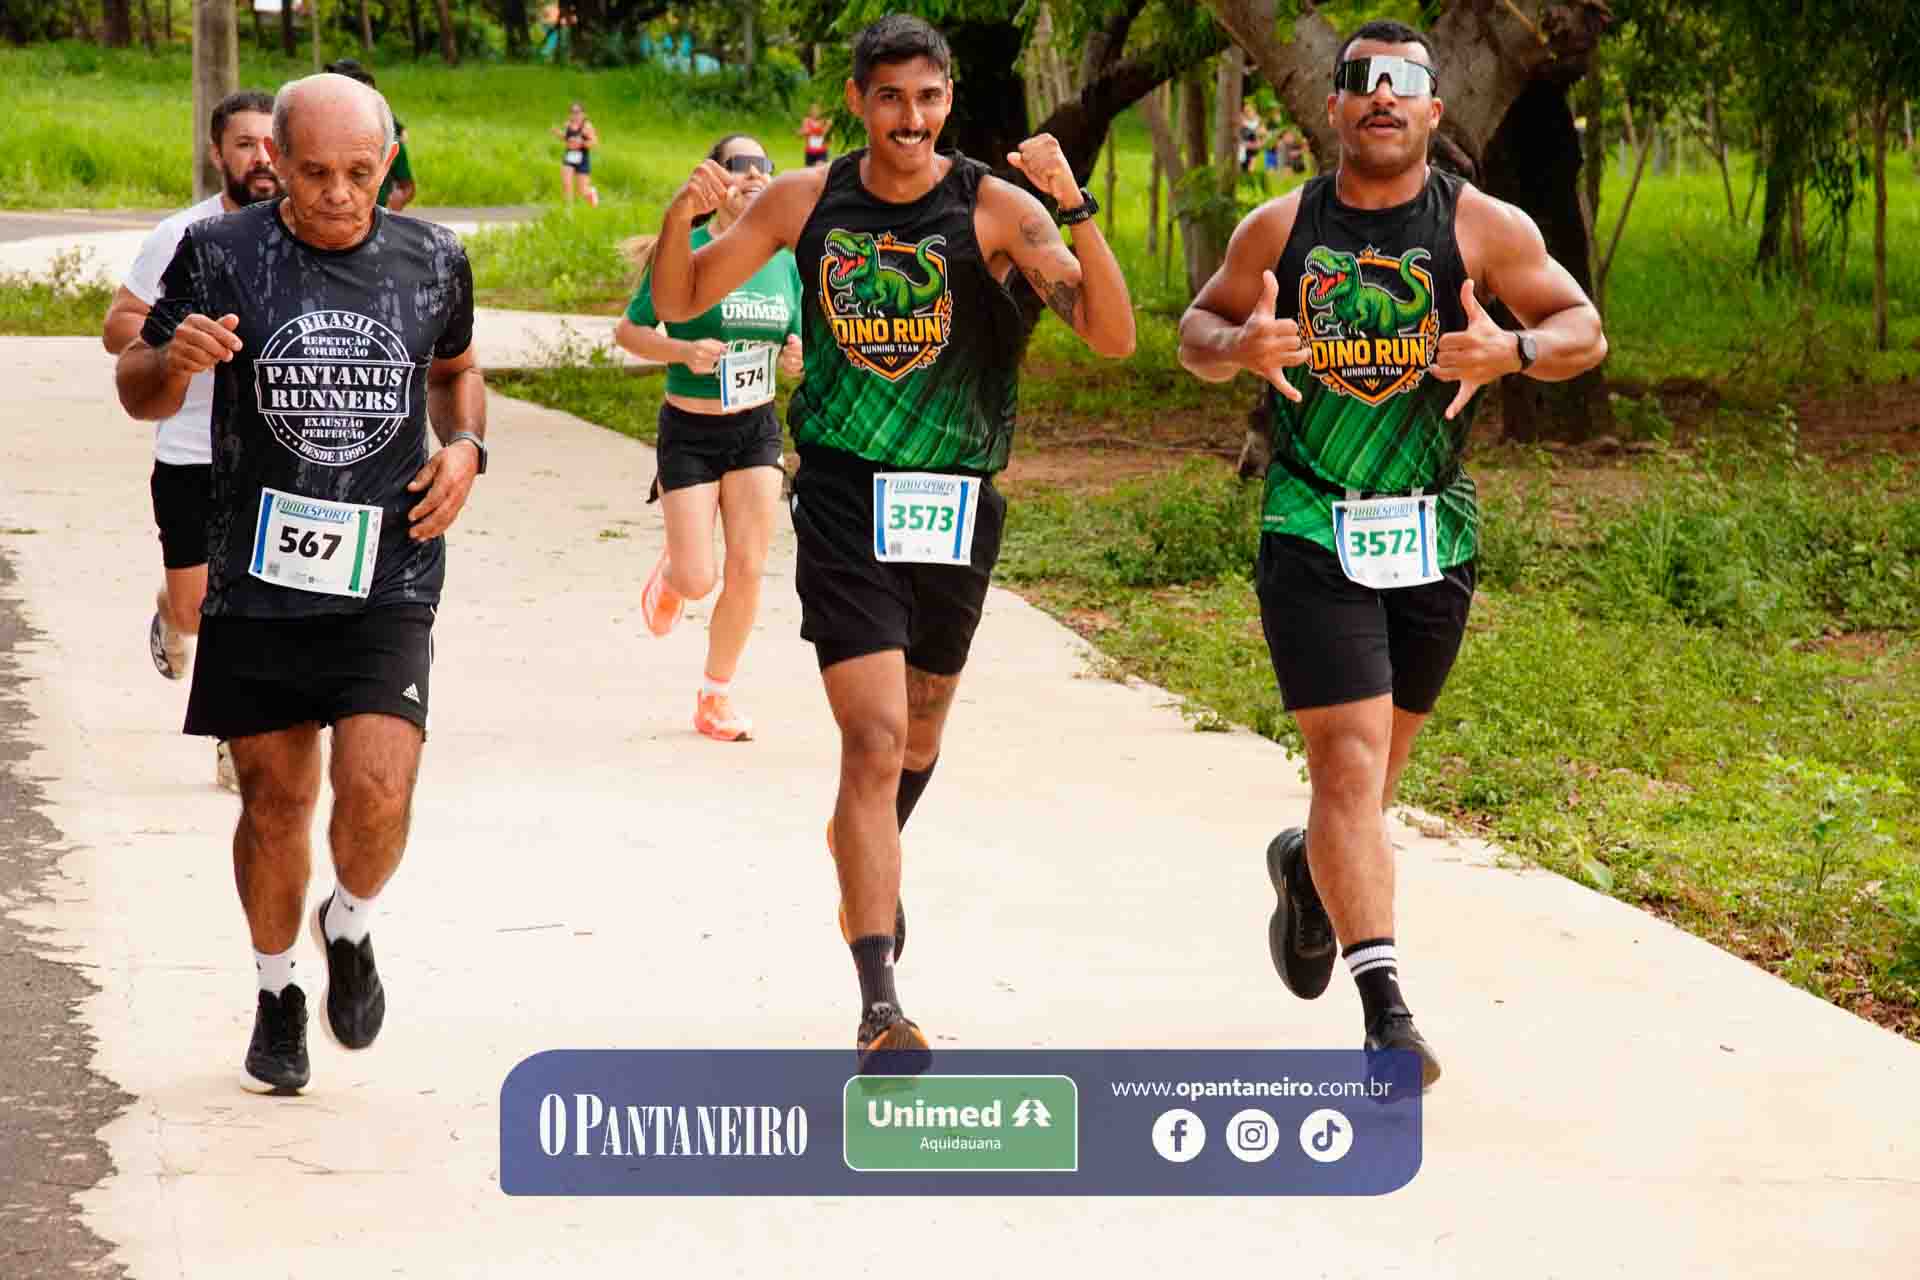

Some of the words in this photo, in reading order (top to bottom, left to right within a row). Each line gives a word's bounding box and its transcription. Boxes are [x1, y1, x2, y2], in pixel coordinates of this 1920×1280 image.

[721, 303, 789, 320] UNIMED
[297, 313, 375, 336] BRASIL
[832, 318, 889, 345] DINO
[894, 318, 942, 343] RUN
[302, 336, 371, 347] REPETIÇÃO
[303, 346, 369, 358] CORREÇÃO
[861, 344, 895, 353] RUNNING
[897, 344, 919, 352] TEAM
[1311, 338, 1371, 370] DINO
[1375, 338, 1427, 367] RUN
[265, 365, 404, 387] PANTANUS
[735, 368, 764, 389] 574
[1341, 367, 1377, 377] RUNNING
[1380, 367, 1403, 376] TEAM
[271, 389, 398, 411] RUNNERS
[304, 417, 364, 428] EXAUSTÃO
[301, 428, 366, 440] PERFEIÇÃO
[298, 443, 336, 462] DESDE
[338, 445, 367, 462] 1999
[889, 504, 955, 532] 3573
[279, 525, 342, 560] 567
[1349, 527, 1418, 556] 3572
